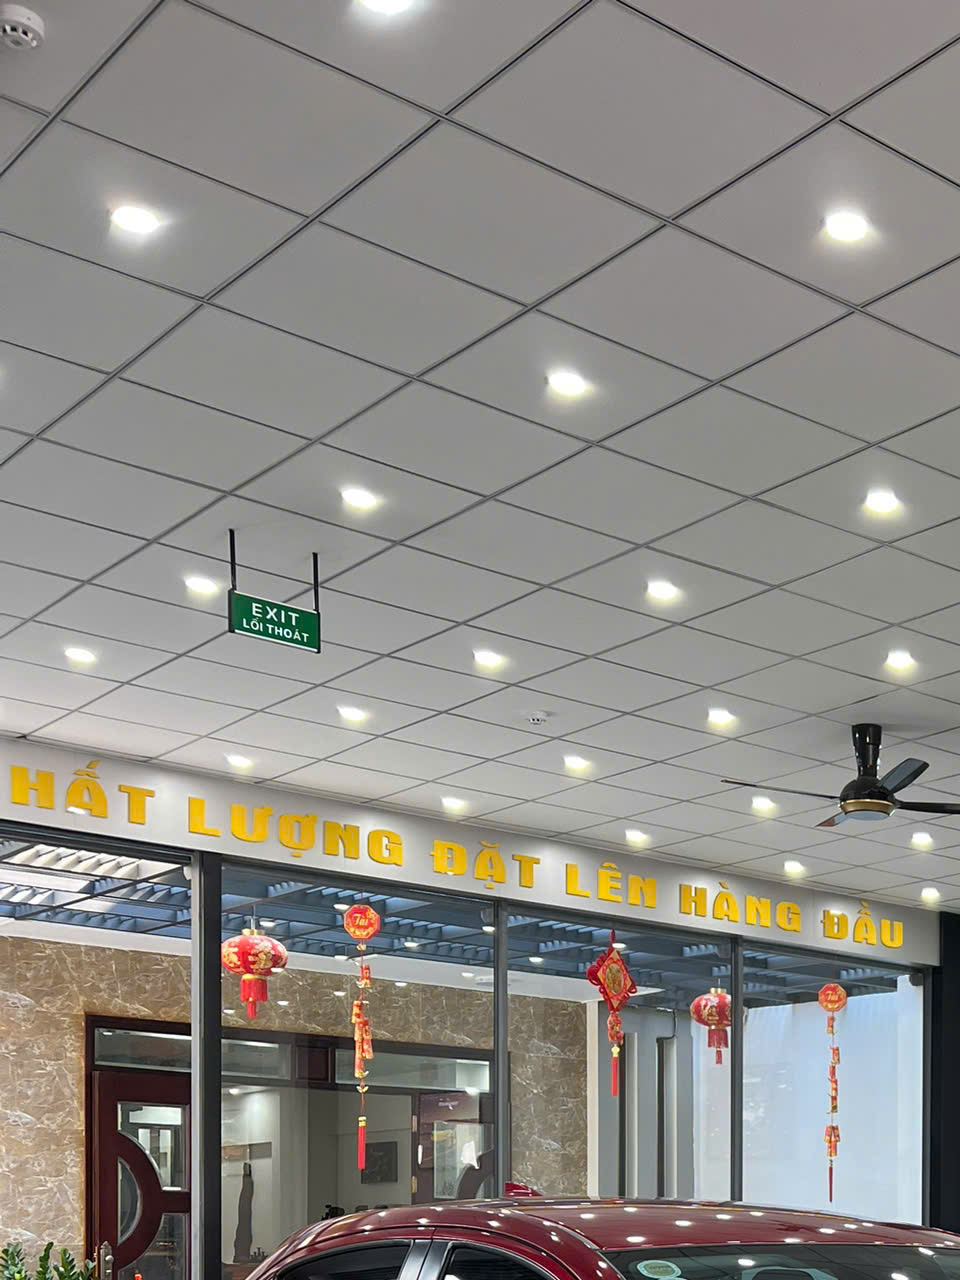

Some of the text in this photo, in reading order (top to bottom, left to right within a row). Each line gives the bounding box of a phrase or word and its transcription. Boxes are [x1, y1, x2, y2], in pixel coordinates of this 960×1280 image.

[252, 602, 299, 625] EXIT
[243, 617, 309, 642] LỐI THOÁT
[9, 760, 905, 949] HẤT LƯỢNG ĐẶT LÊN HÀNG ĐẦU
